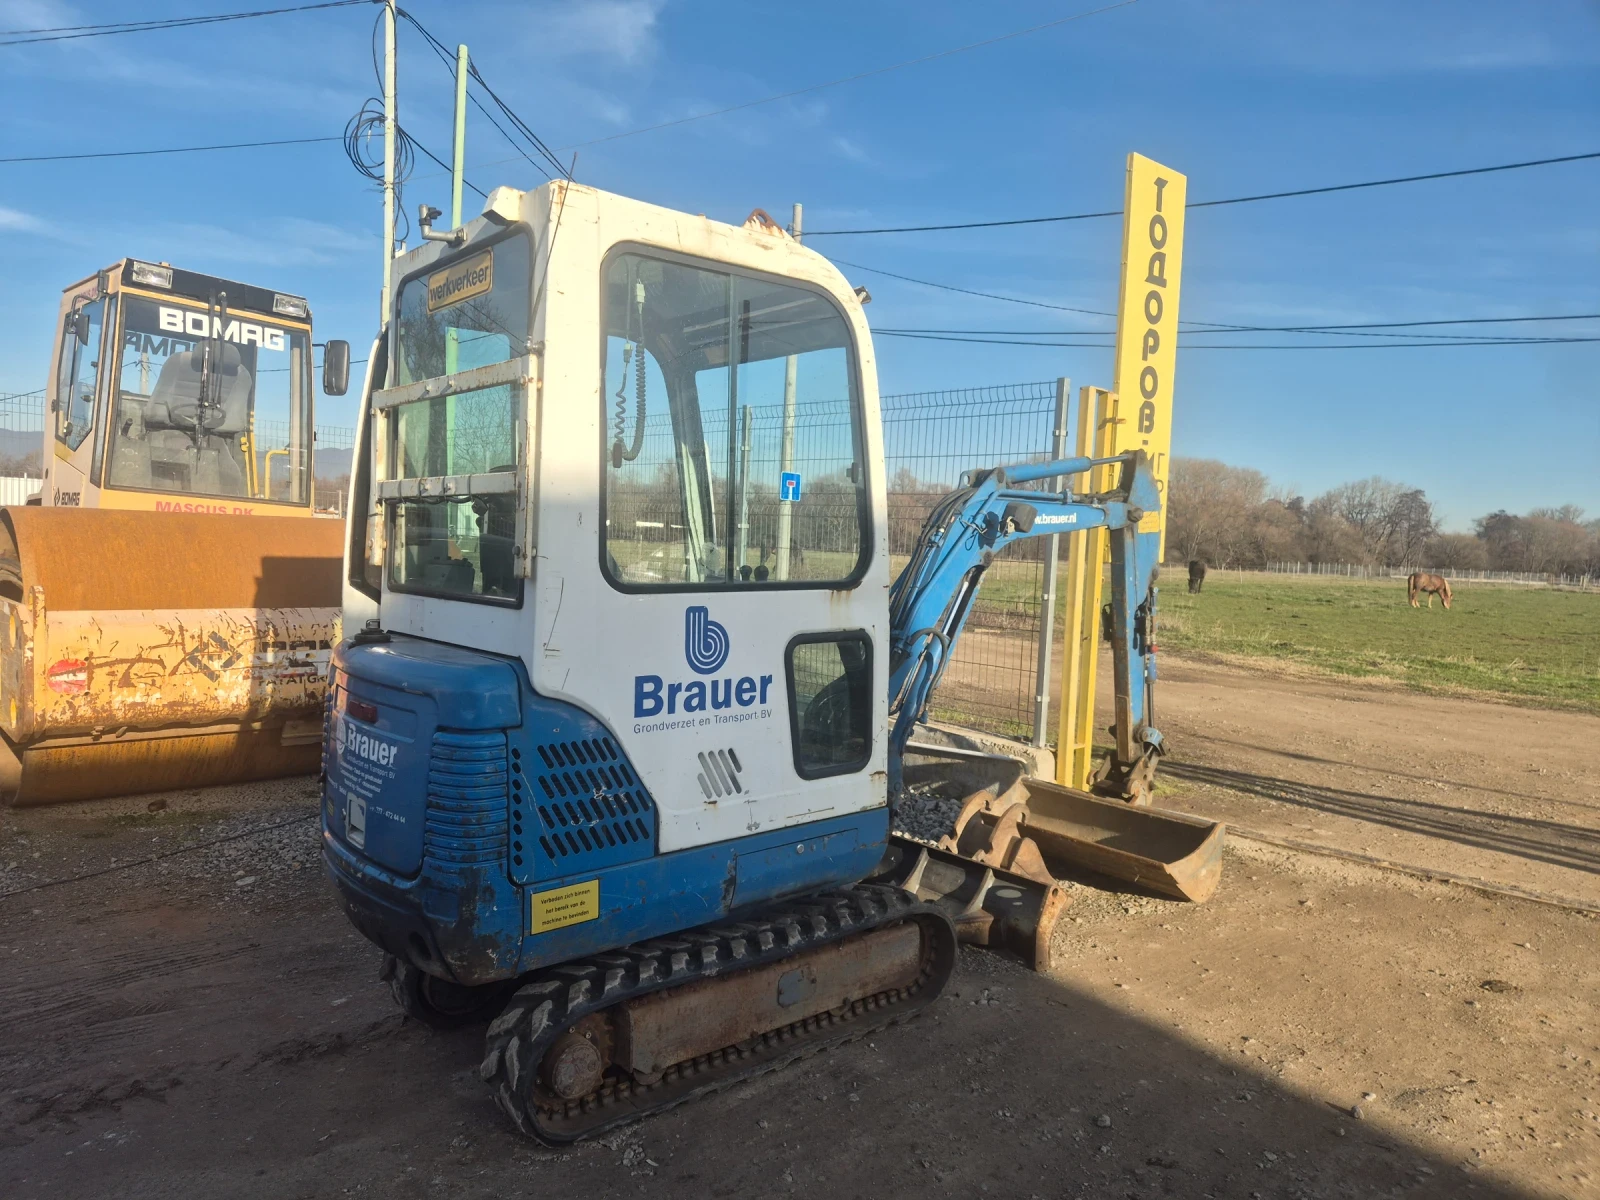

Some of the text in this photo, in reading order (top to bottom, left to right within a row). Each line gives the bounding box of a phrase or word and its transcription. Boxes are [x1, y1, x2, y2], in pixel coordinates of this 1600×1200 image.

[429, 265, 489, 302] werkverkeer
[159, 306, 285, 351] BOMAG
[60, 492, 81, 506] BOMAG
[155, 500, 227, 515] MASCUS
[1034, 512, 1077, 525] w.brauer.nl
[633, 674, 773, 719] Brauer
[633, 709, 773, 734] Grondverzet en Transport BV
[347, 723, 398, 767] Brauer
[564, 892, 574, 900] zich
[541, 916, 562, 926] machine
[568, 910, 590, 919] bevinden
